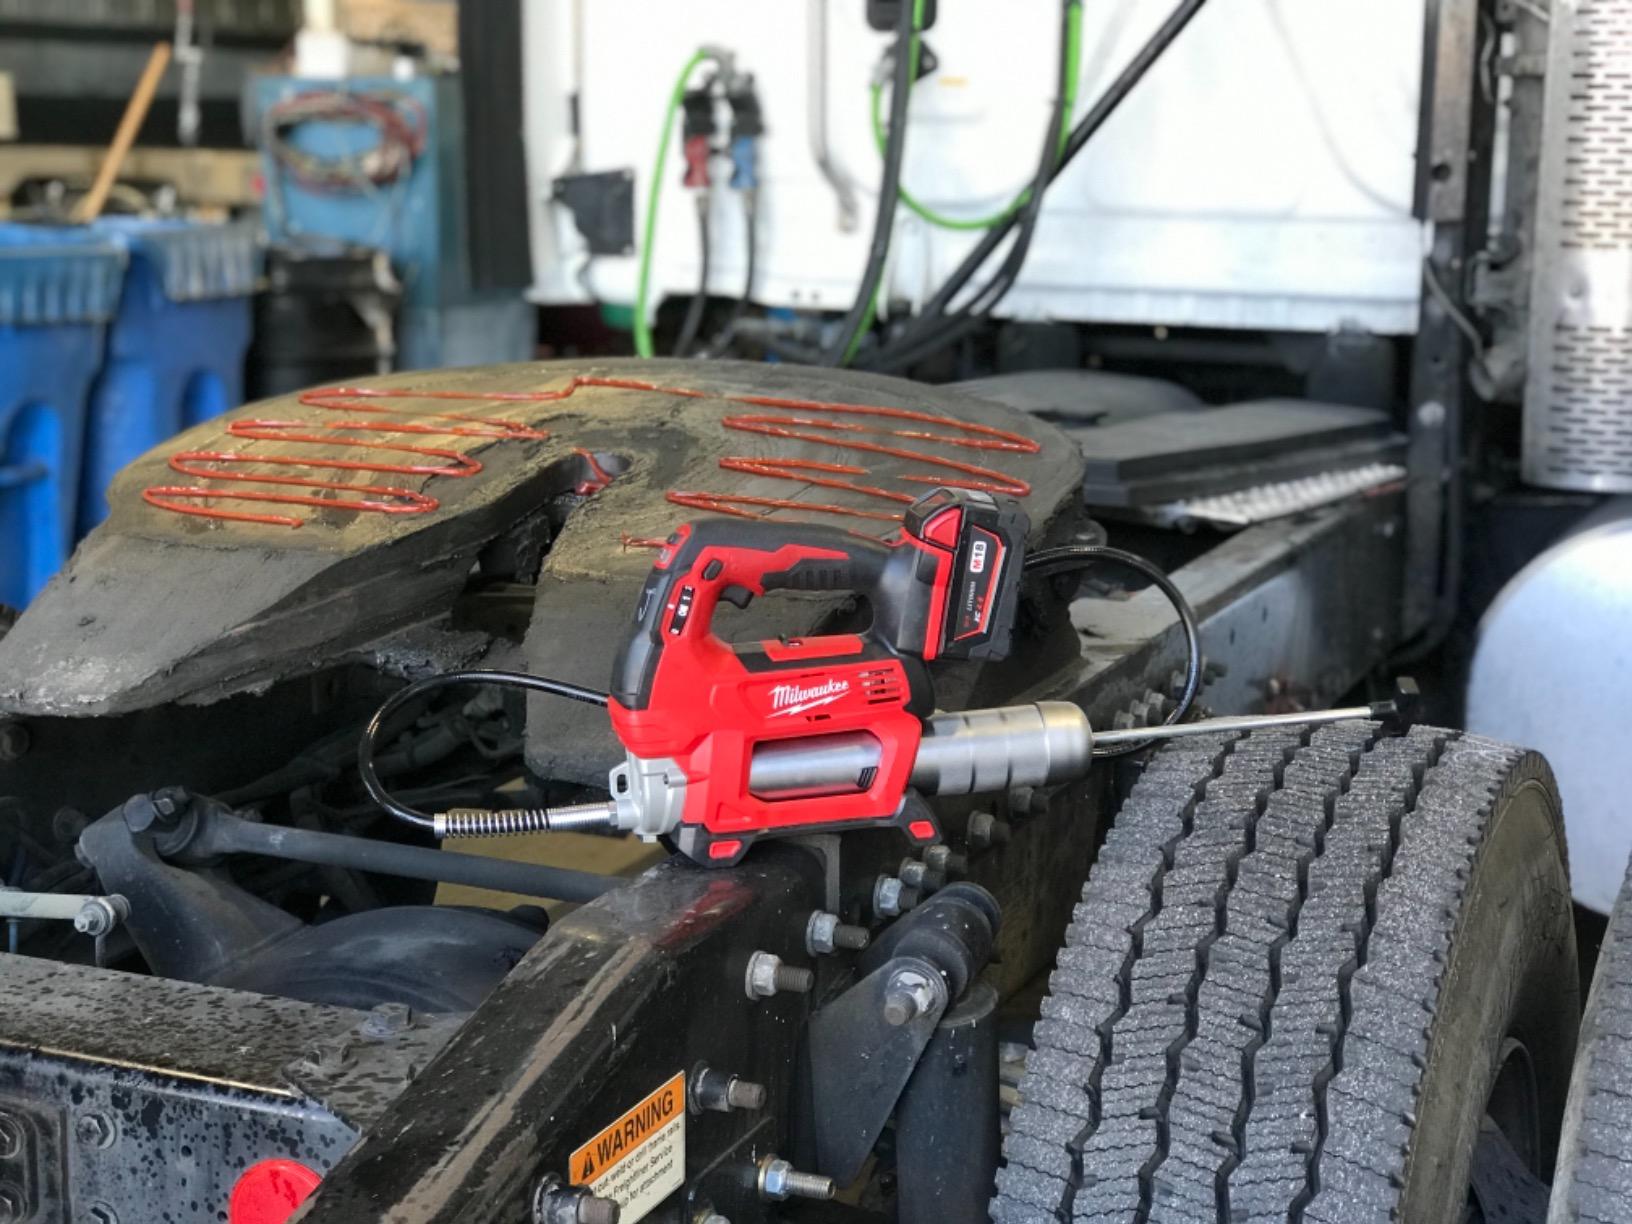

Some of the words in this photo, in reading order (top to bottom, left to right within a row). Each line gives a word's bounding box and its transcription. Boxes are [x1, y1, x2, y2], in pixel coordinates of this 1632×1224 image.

[972, 543, 984, 571] M18
[768, 678, 849, 709] Milwaukee
[597, 1089, 673, 1166] WARNING
[650, 1144, 672, 1168] Service
[640, 1159, 673, 1192] attachment
